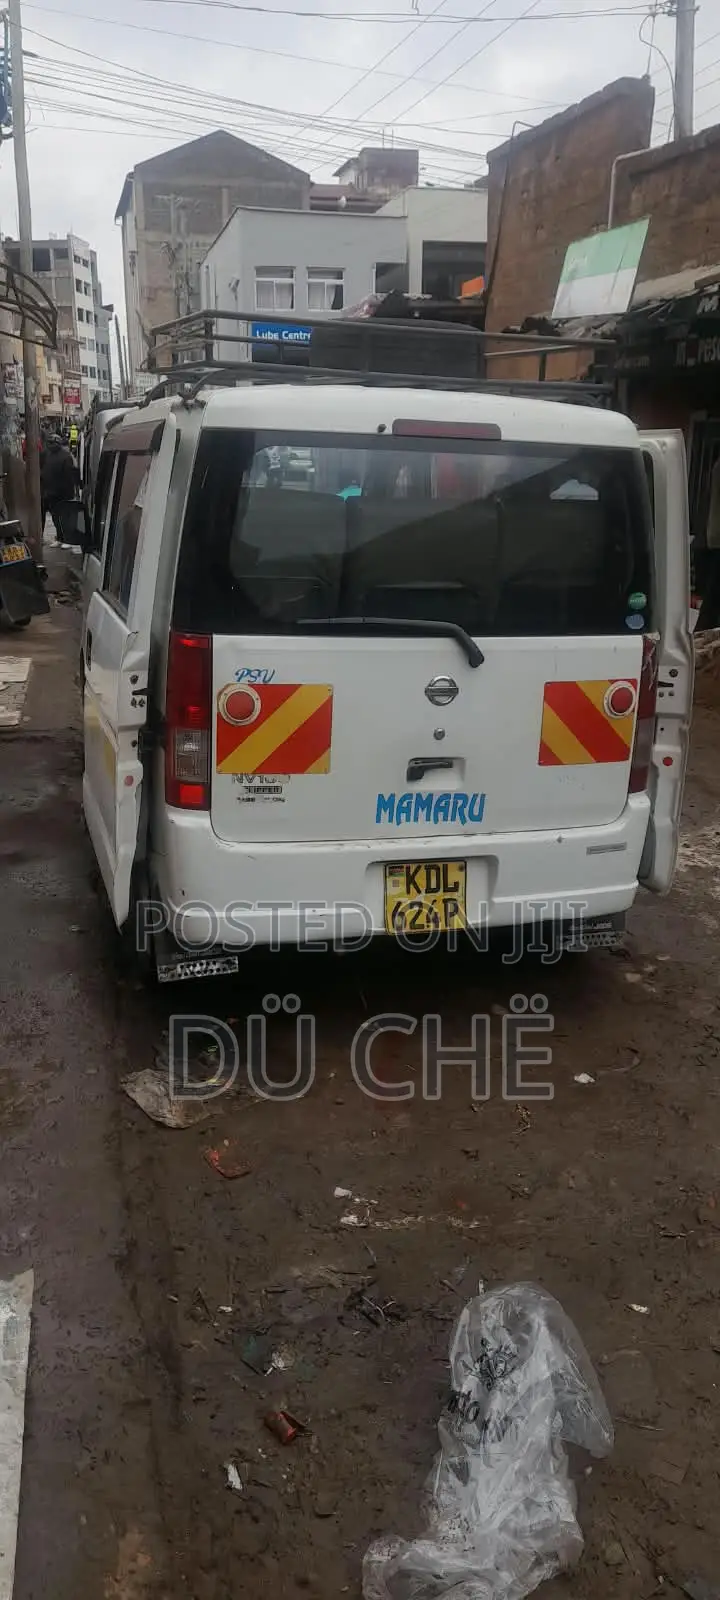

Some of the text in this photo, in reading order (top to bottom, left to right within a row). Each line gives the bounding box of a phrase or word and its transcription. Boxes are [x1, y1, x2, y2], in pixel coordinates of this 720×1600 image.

[256, 329, 279, 340] Lube
[375, 792, 486, 826] MAMARU
[405, 864, 460, 895] KDL
